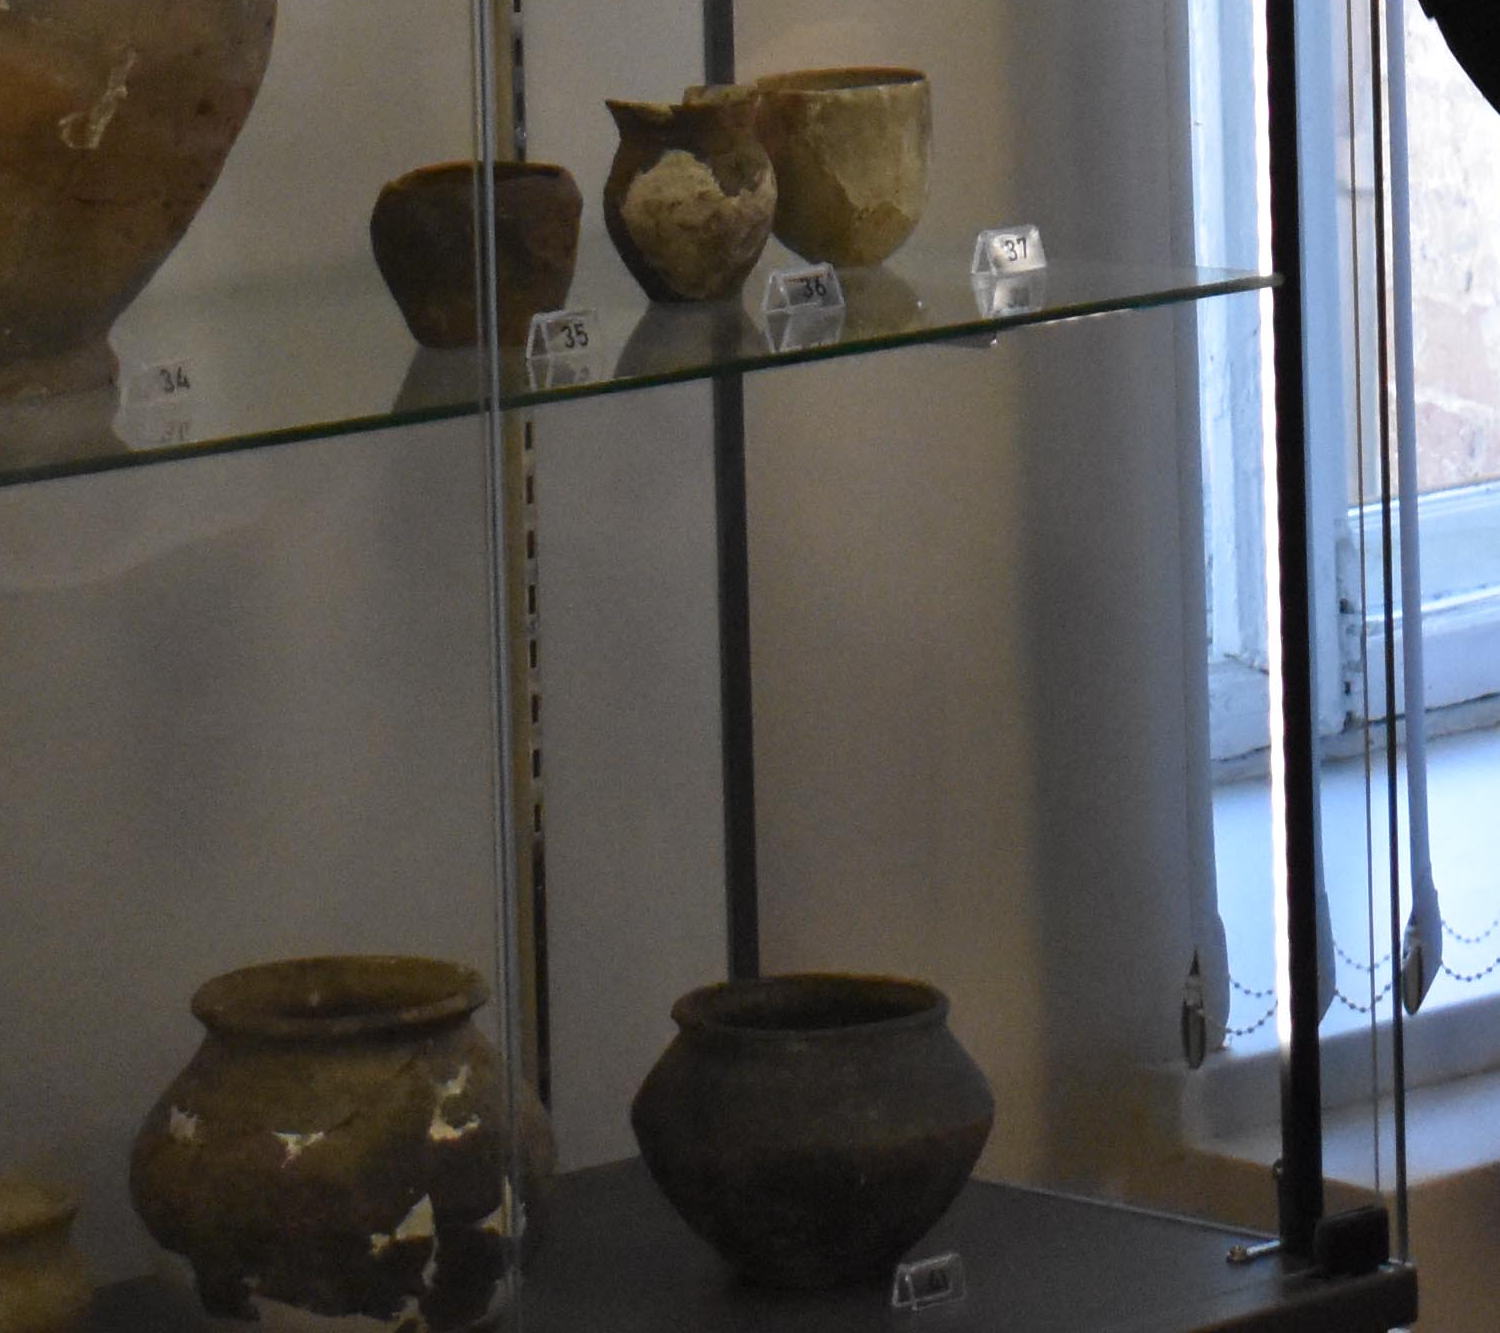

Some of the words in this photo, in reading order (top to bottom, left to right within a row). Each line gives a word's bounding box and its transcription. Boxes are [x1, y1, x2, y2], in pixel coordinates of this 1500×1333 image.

[1005, 236, 1028, 262] 37
[799, 275, 827, 298] 36
[561, 323, 589, 348] 35
[160, 366, 190, 393] 34
